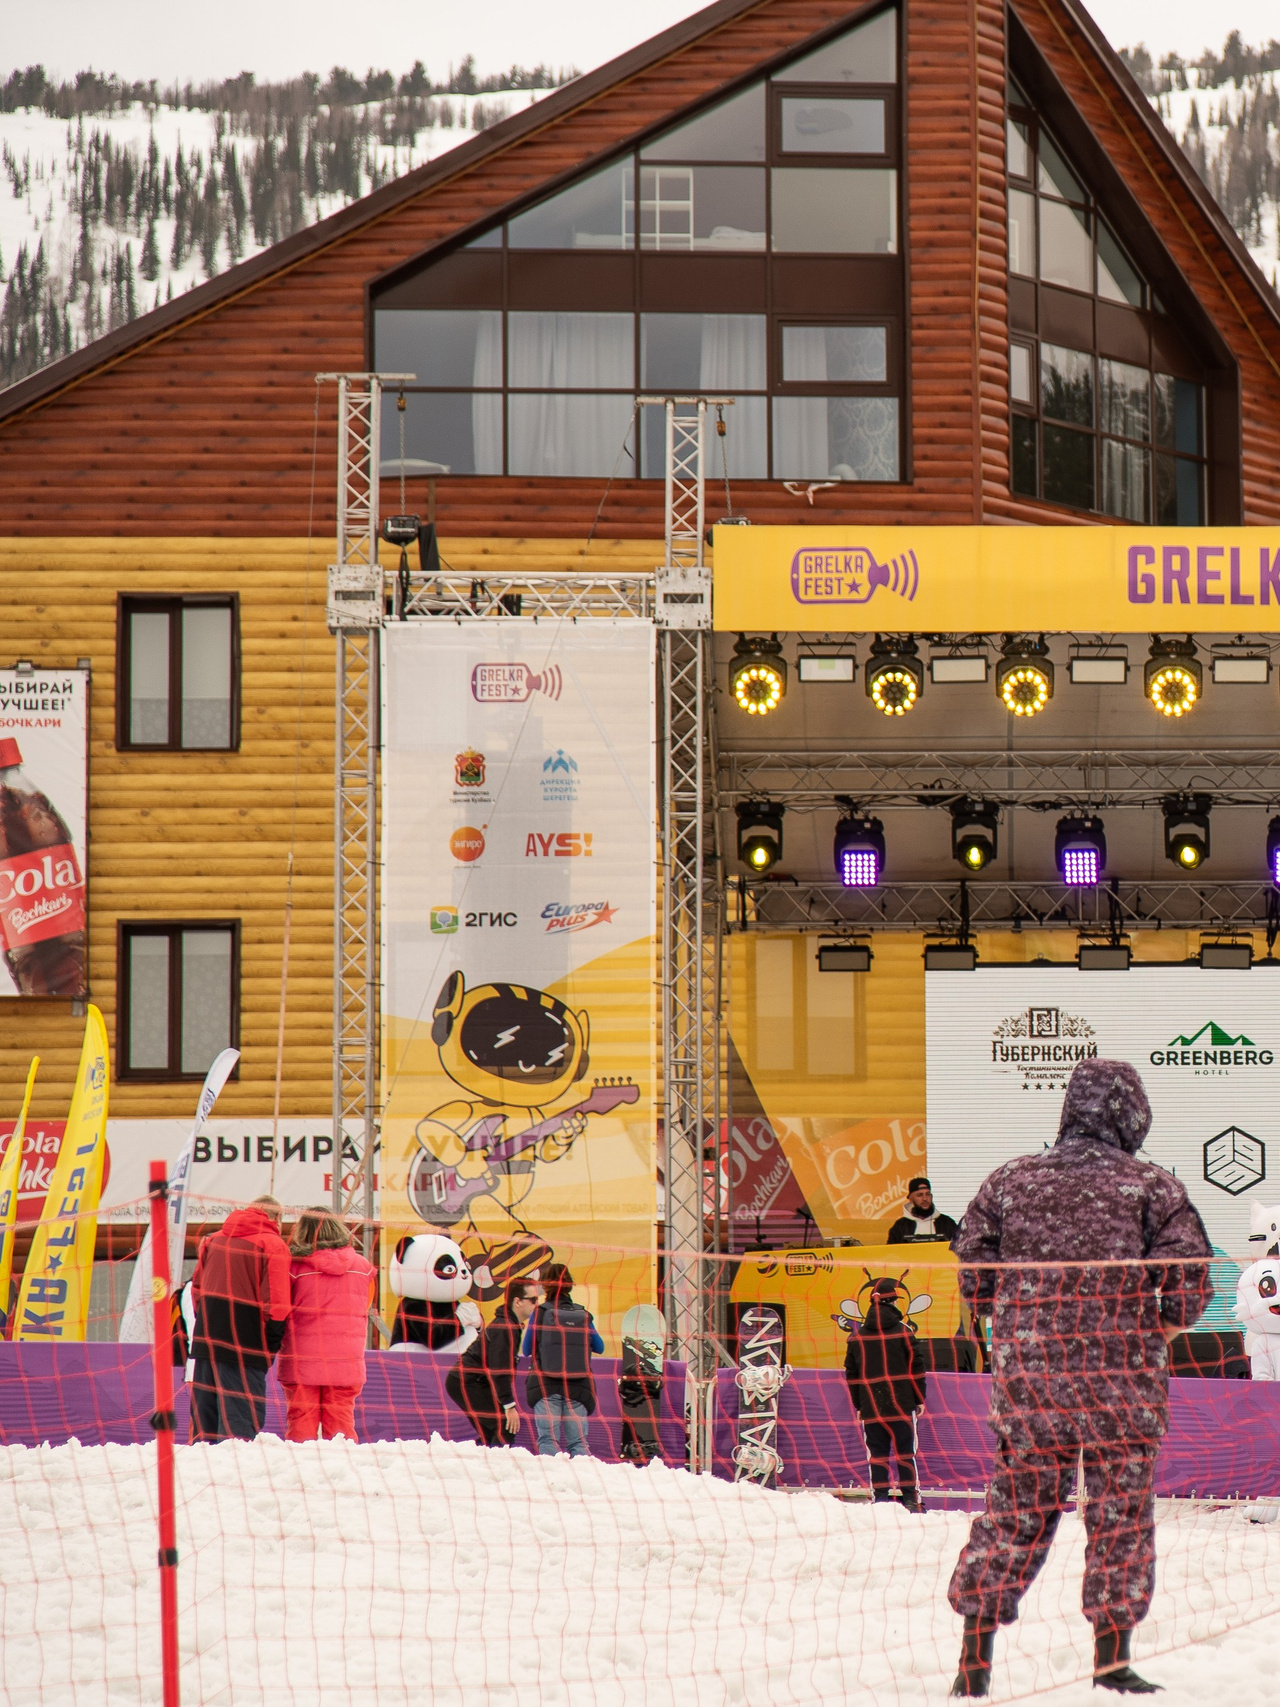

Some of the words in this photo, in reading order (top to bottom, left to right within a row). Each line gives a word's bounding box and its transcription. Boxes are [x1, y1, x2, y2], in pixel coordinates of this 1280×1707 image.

[803, 555, 864, 576] GRELKA
[803, 577, 845, 597] FEST
[480, 668, 523, 682] GRELKA
[480, 683, 509, 697] FEST
[525, 832, 593, 857] AYS!
[465, 911, 518, 928] 2ГИС
[1150, 1050, 1274, 1067] GREENBERG
